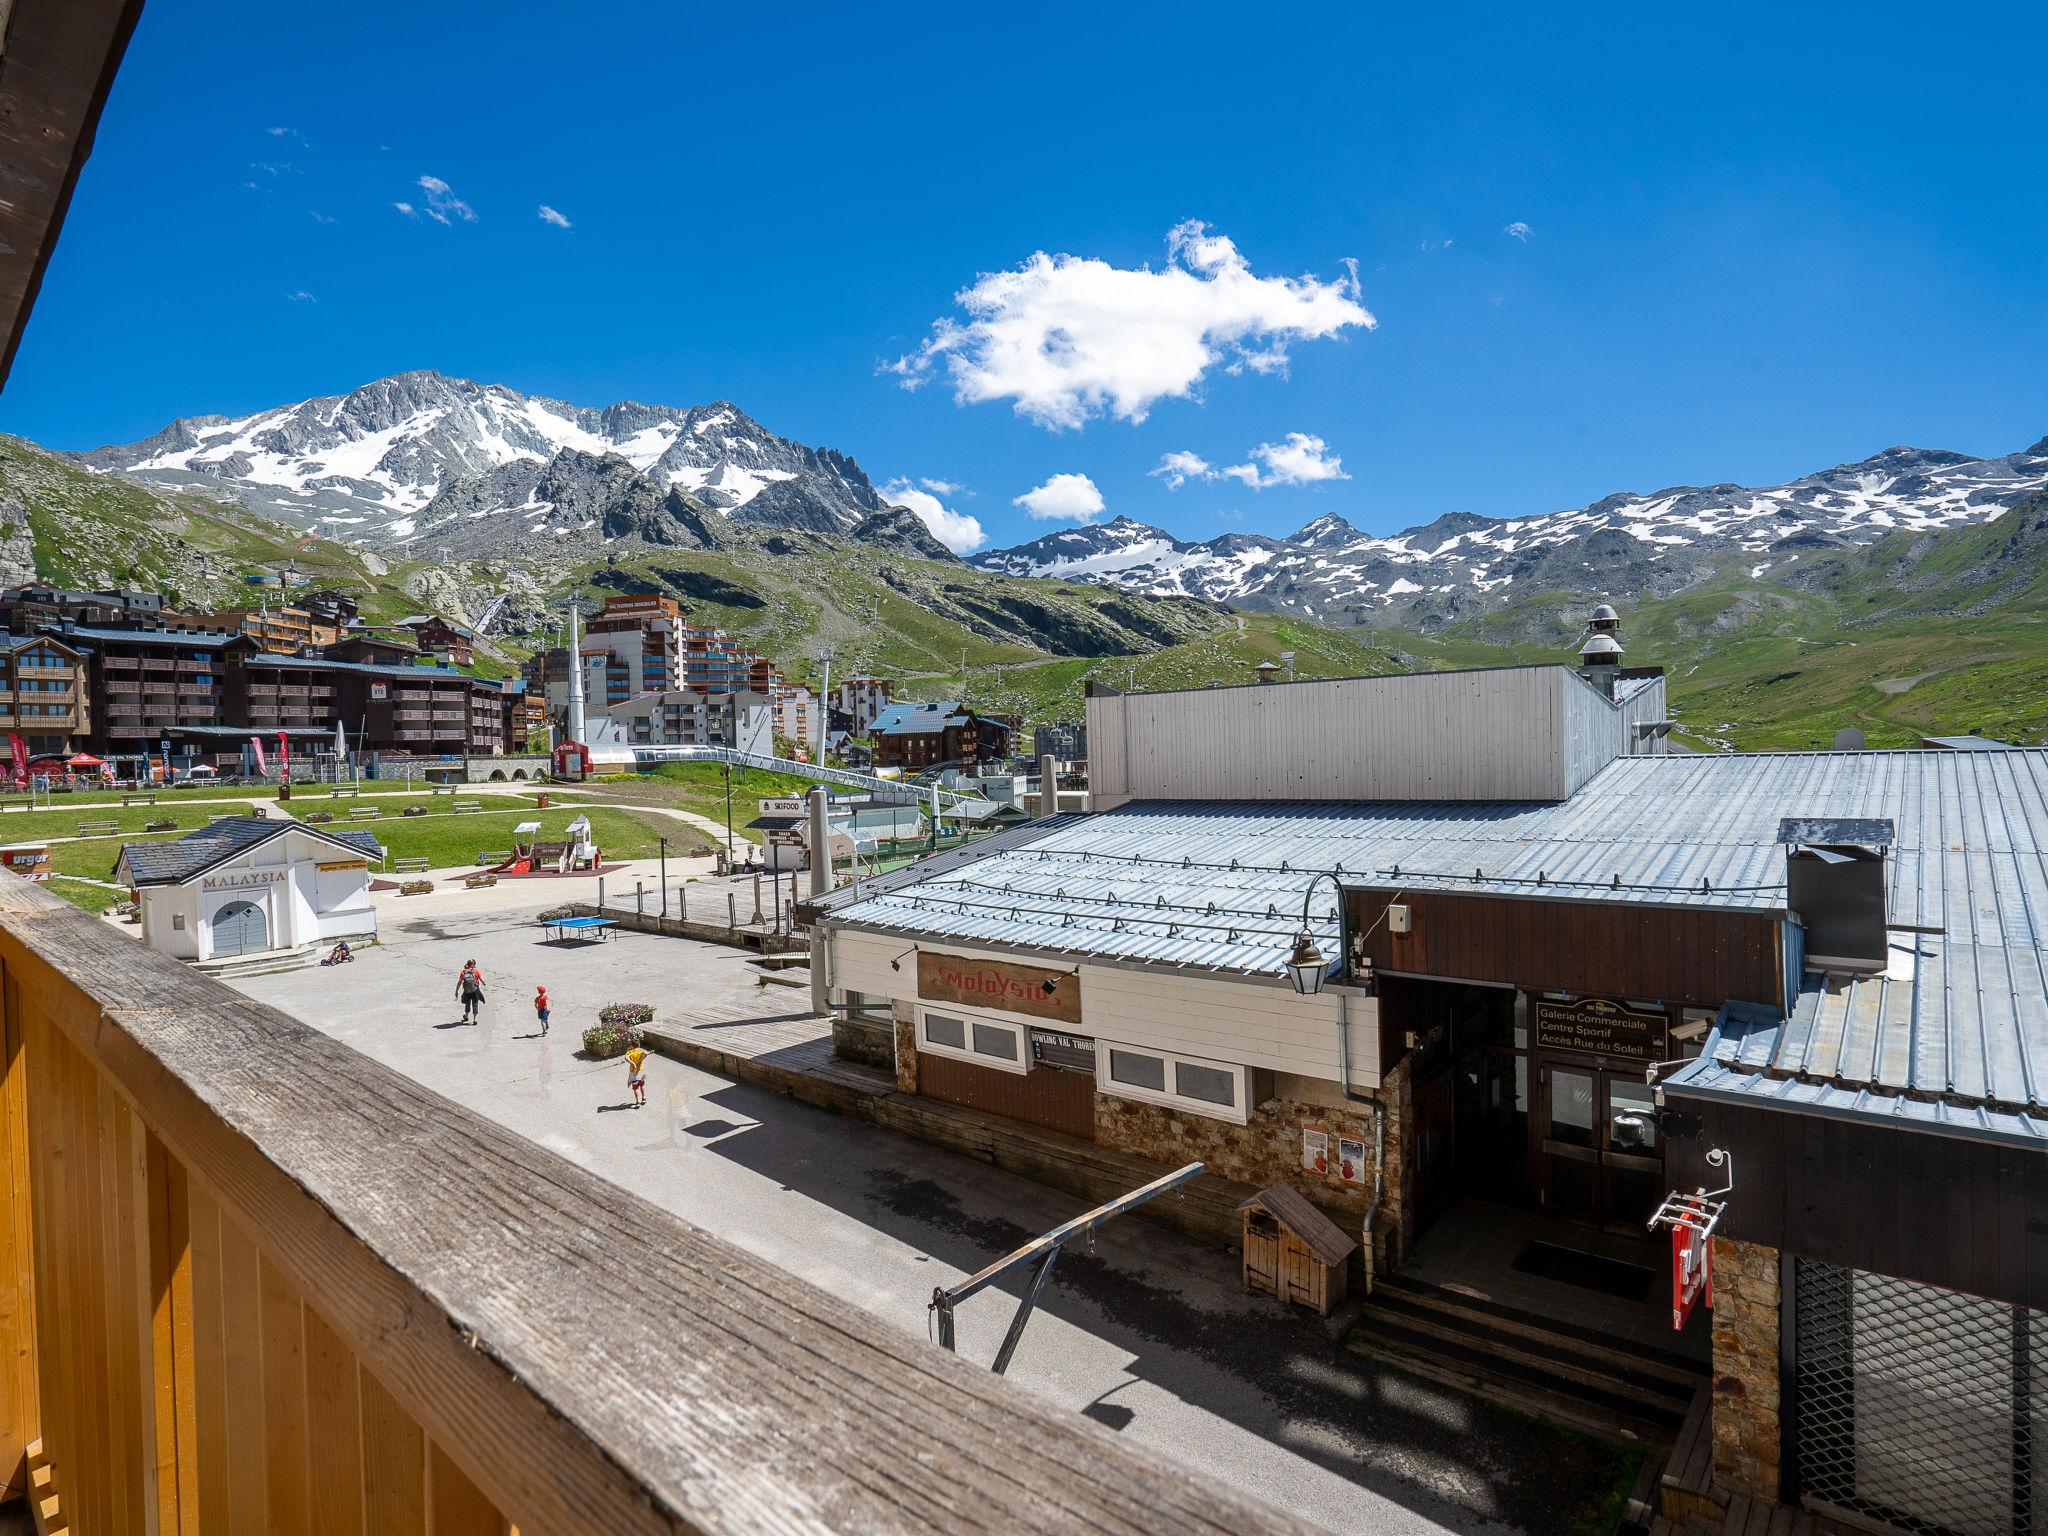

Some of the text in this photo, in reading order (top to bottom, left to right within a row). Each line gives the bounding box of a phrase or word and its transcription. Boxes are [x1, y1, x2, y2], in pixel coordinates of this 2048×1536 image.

[203, 872, 286, 888] MALAYSIA
[1540, 1008, 1647, 1030] Galerie Commerciale
[1540, 1021, 1612, 1038] Centre Sportif
[1031, 1032, 1057, 1045] BOWLING
[1058, 1037, 1071, 1047] VAL
[1541, 1033, 1643, 1055] Accès Rue du Soleil
